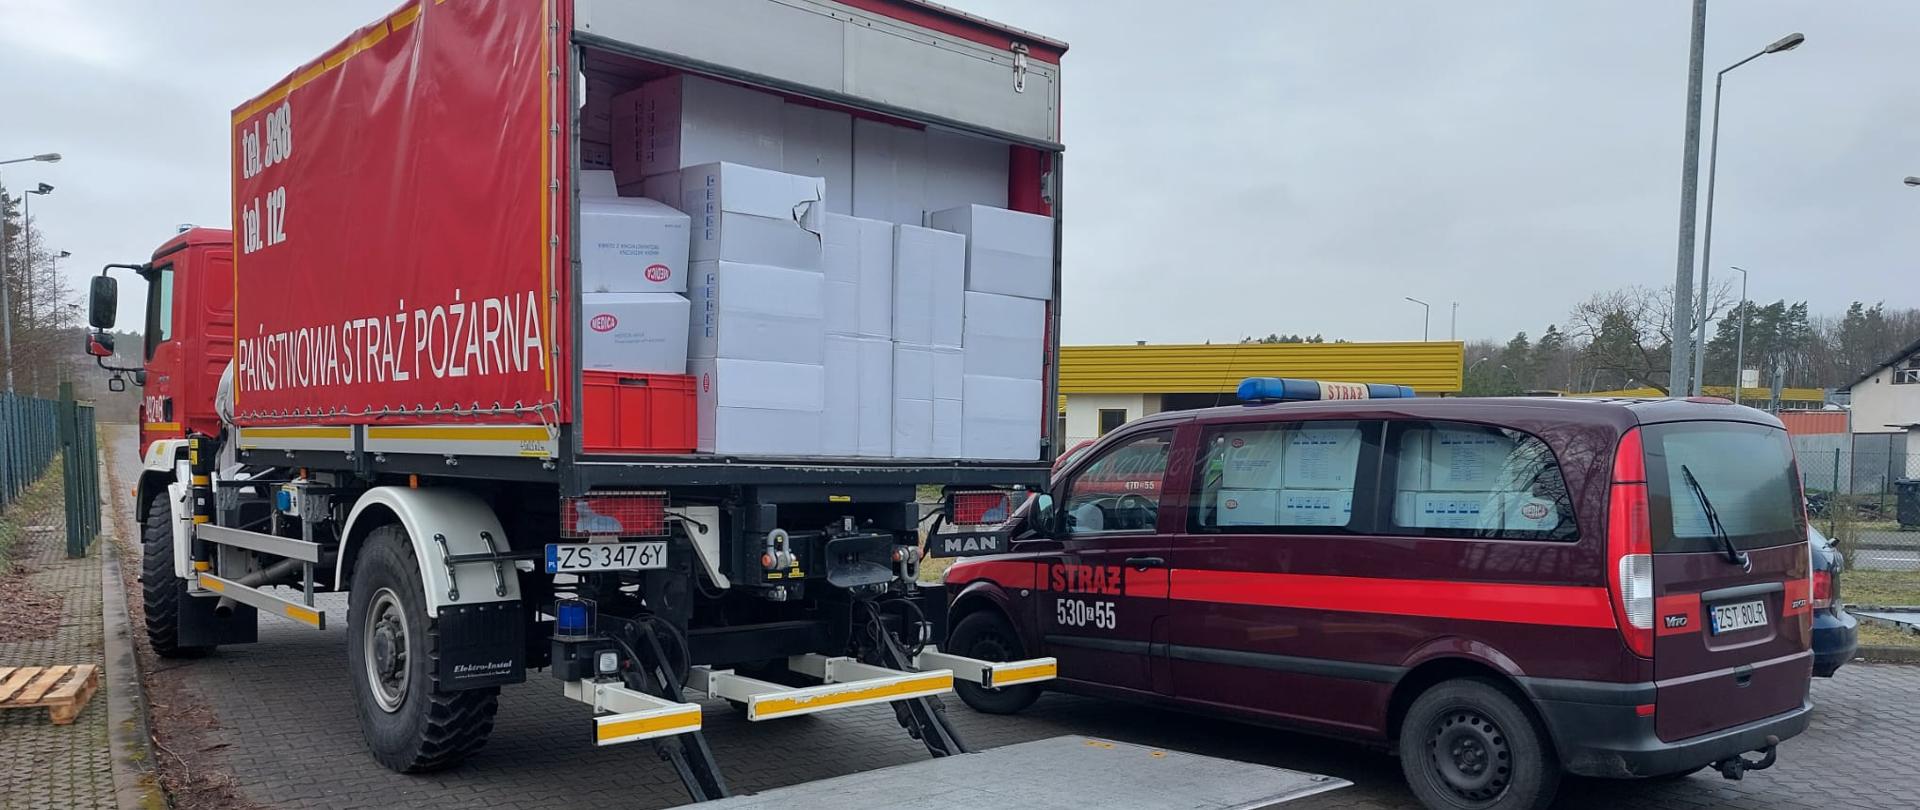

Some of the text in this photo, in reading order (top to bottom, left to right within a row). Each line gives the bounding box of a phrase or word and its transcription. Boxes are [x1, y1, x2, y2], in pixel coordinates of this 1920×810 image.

[242, 186, 287, 255] tel. 112
[646, 266, 670, 281] MEDICA
[592, 316, 615, 330] MEDICA
[239, 288, 545, 392] PAŃSTWOWA STRAŻ POŻARNA
[561, 544, 663, 569] ZS 3476Y
[944, 535, 997, 553] MAN
[1716, 606, 1739, 629] ZST
[1741, 603, 1766, 626] 80LR
